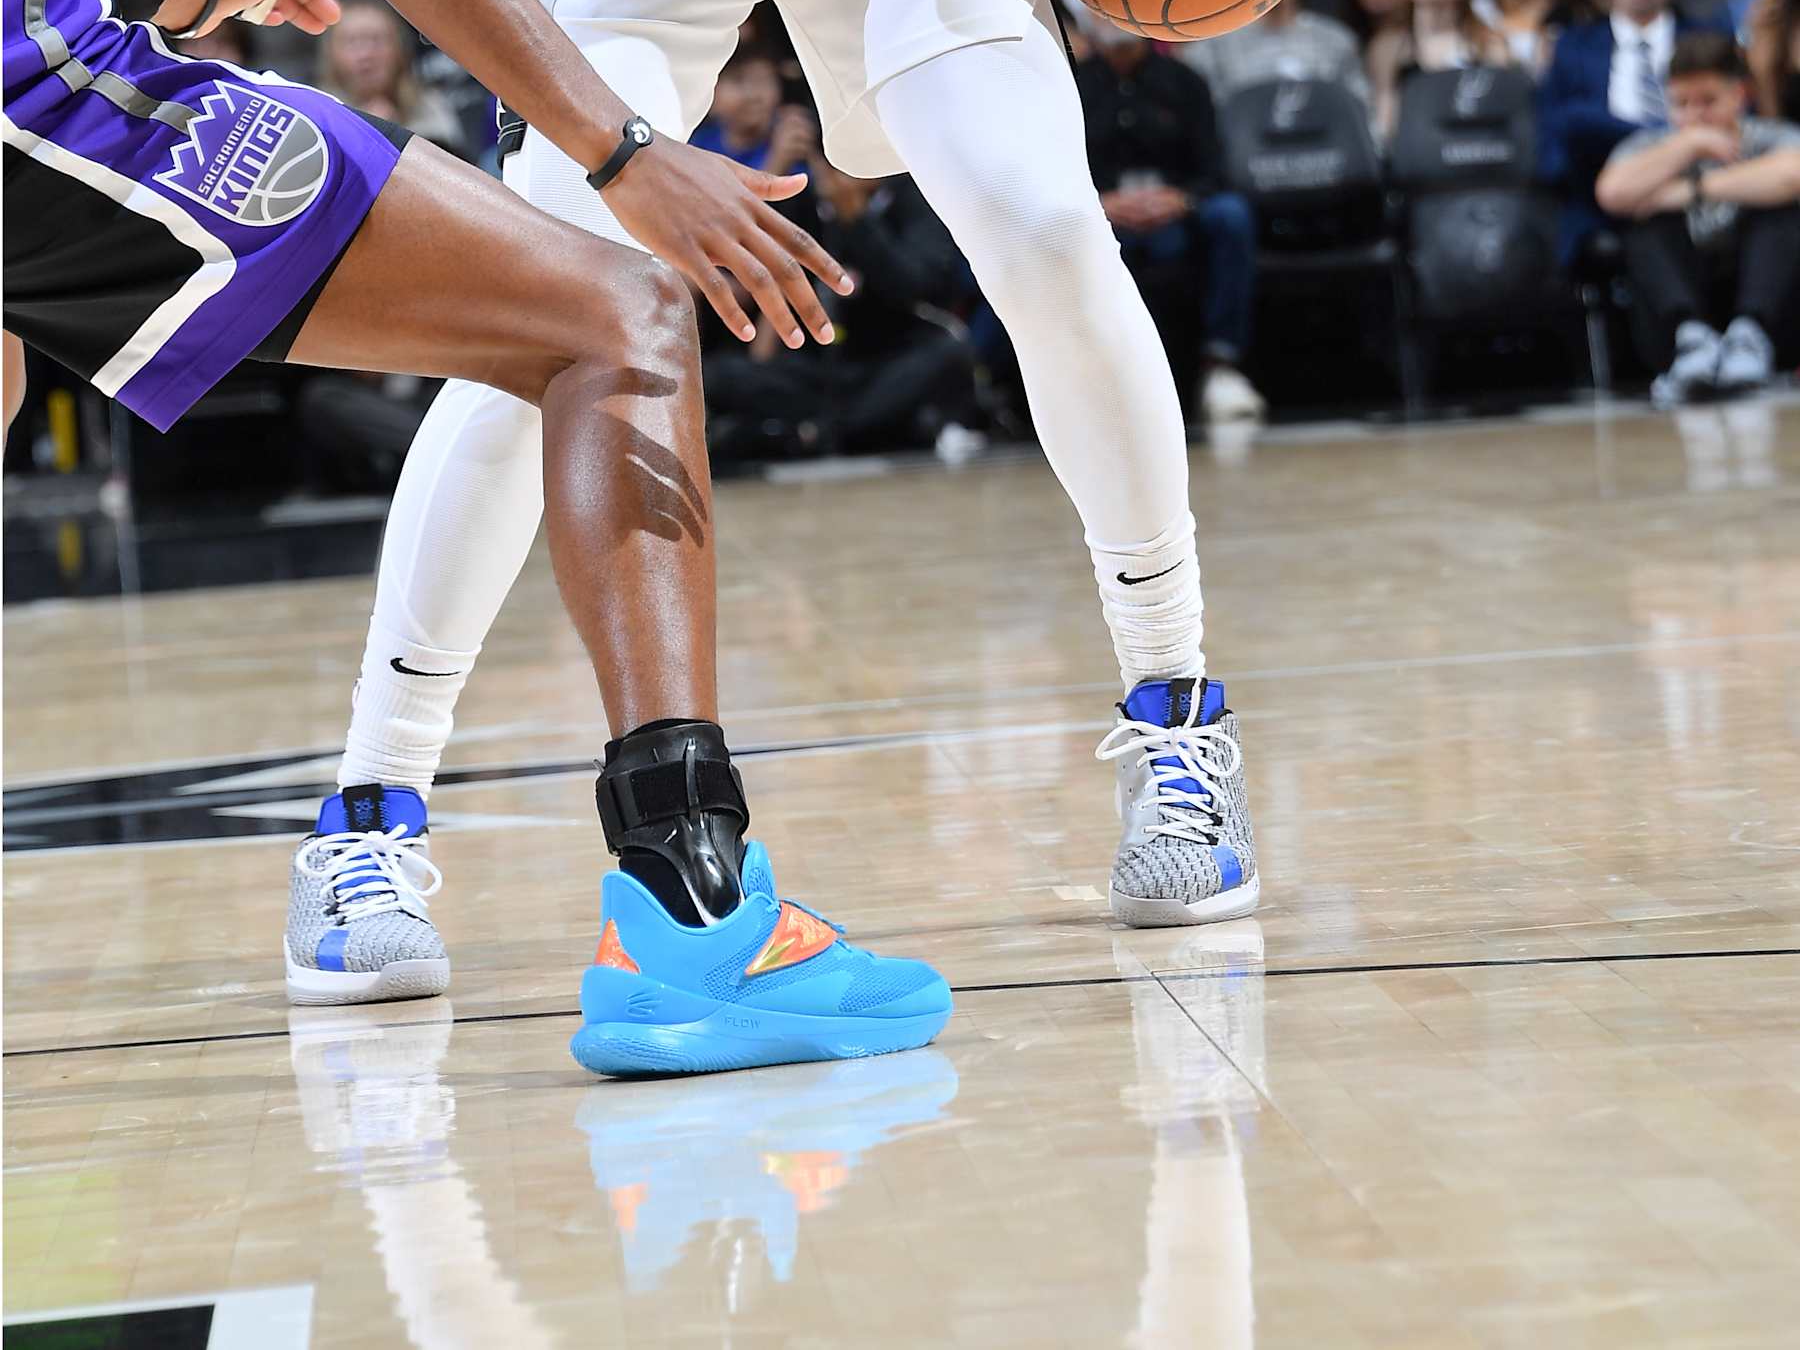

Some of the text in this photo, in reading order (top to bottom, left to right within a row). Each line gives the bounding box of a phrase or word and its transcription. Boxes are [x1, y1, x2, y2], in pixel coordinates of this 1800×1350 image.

[197, 99, 262, 196] SACRAMENTO
[212, 102, 296, 217] KINGS
[723, 1016, 761, 1029] FLOW
